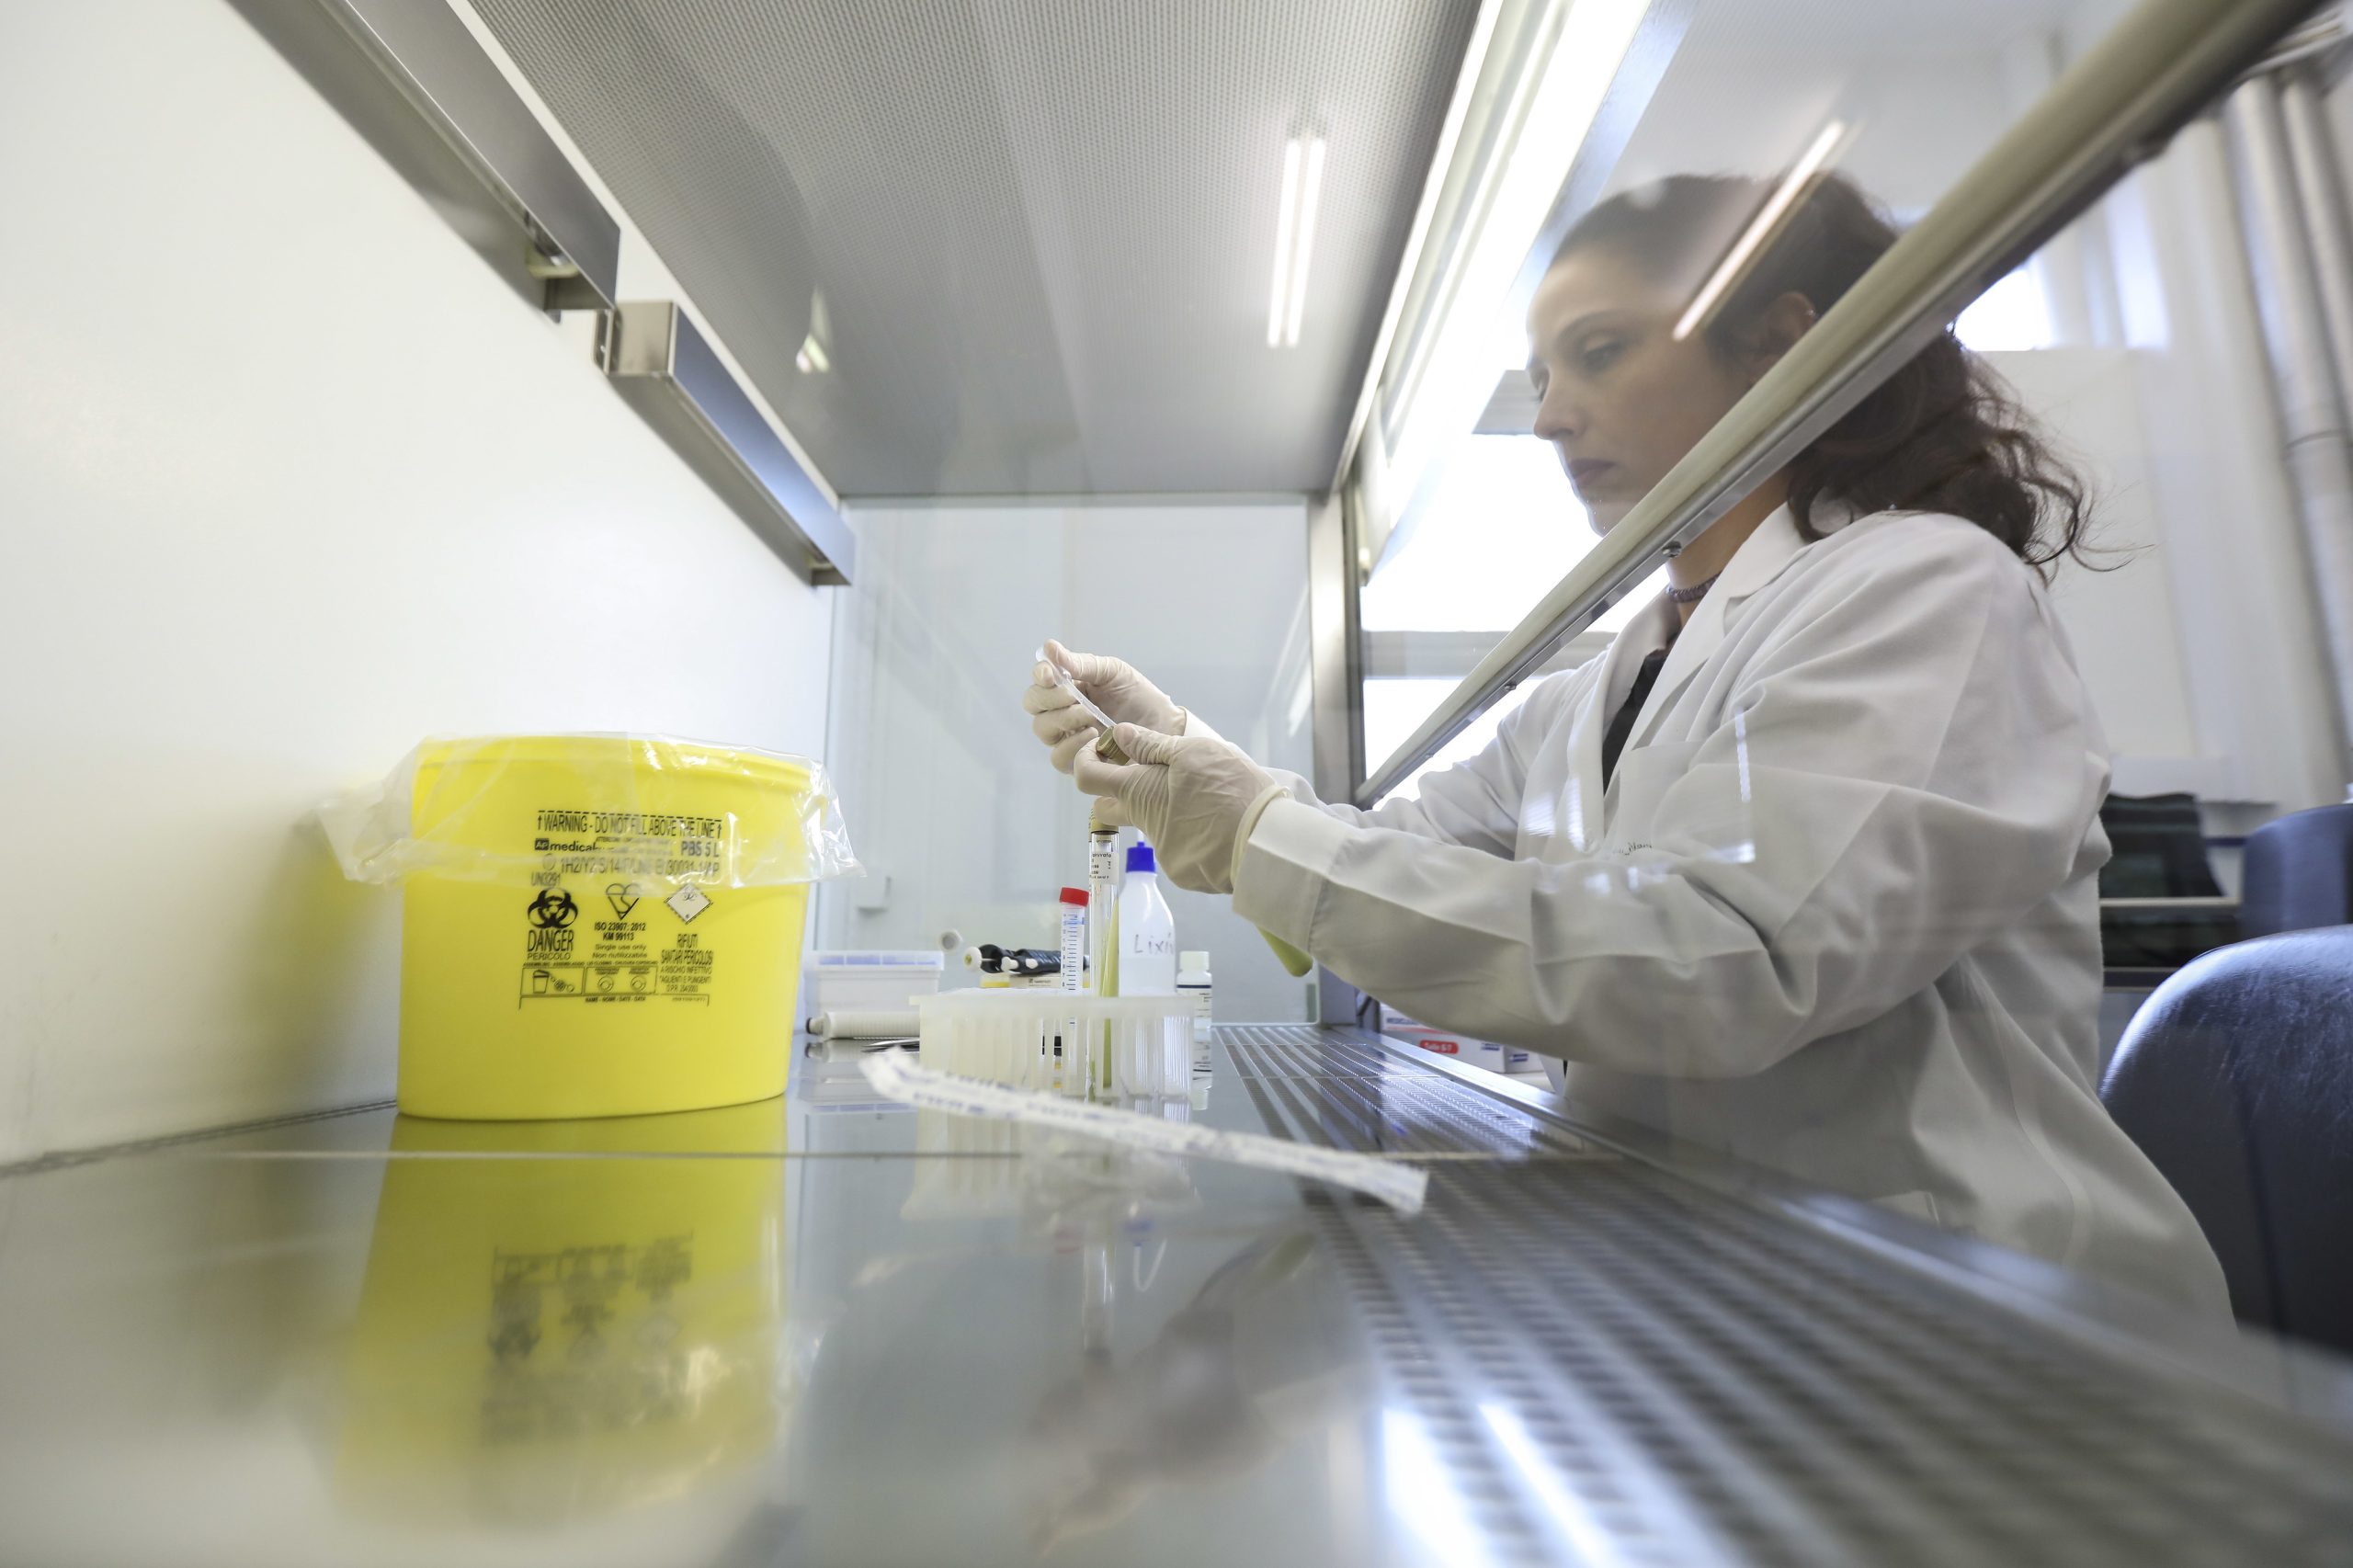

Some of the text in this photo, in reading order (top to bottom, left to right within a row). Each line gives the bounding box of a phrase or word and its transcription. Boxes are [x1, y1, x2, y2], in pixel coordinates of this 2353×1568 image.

[544, 814, 587, 833] WARNING
[595, 816, 608, 834] DO
[610, 816, 630, 834] NOT
[631, 817, 647, 835] FILL
[648, 818, 676, 836] ABOVE
[679, 819, 695, 838] THE
[697, 821, 714, 838] LINE
[550, 840, 596, 852] medical
[681, 840, 702, 857] PBS
[705, 842, 711, 857] 5
[714, 843, 720, 857] L
[595, 922, 607, 931] ISO
[528, 929, 574, 952] DANGER
[527, 951, 572, 960] PERICOLO
